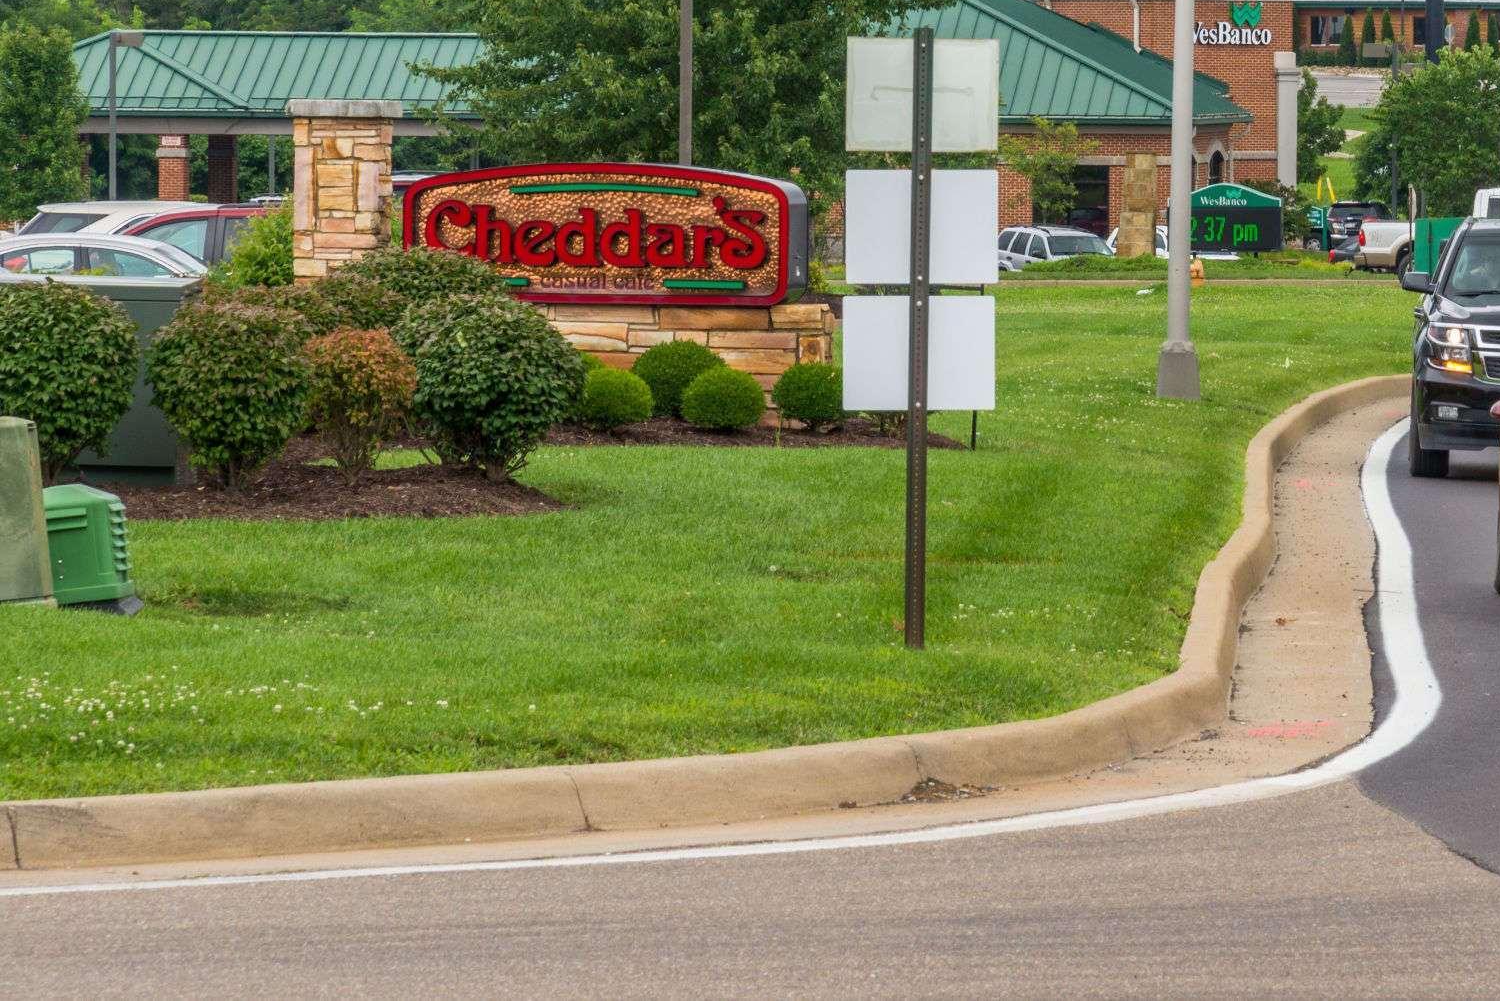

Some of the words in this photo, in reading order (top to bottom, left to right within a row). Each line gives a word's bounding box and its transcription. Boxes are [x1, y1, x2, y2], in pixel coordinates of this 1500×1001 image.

[1200, 195, 1248, 207] WesBanco
[1203, 216, 1226, 242] 37
[1232, 223, 1258, 246] pm
[541, 275, 607, 290] casual
